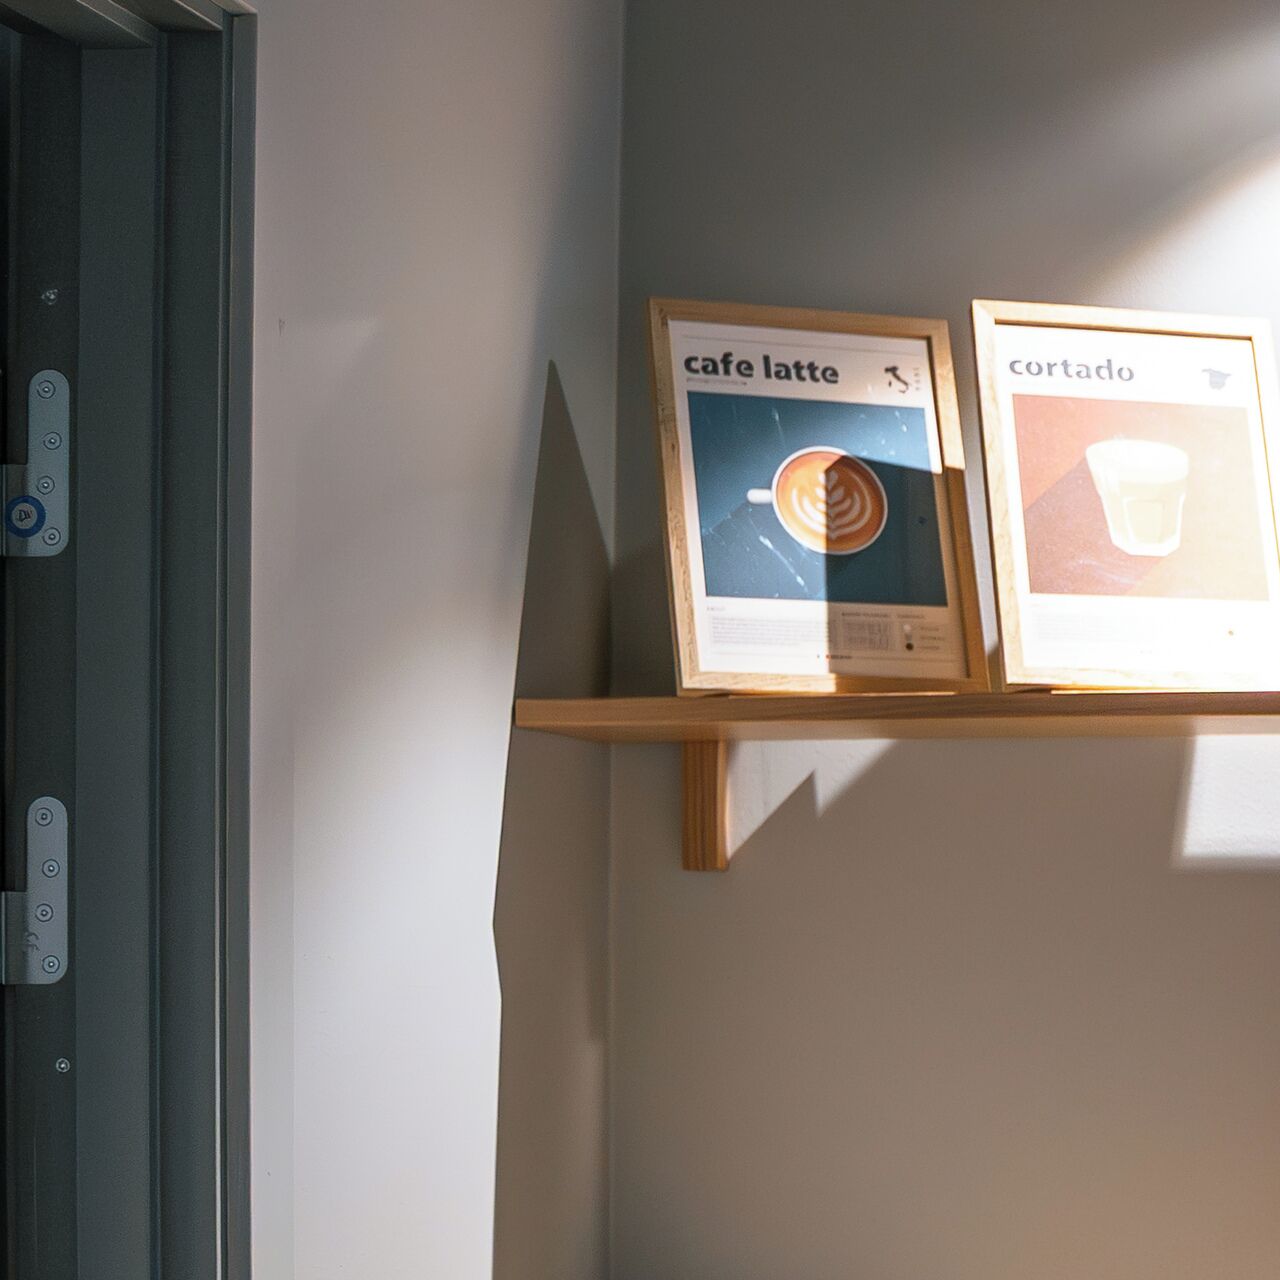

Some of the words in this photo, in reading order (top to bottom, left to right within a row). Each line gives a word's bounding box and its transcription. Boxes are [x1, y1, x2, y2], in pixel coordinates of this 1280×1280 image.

[684, 352, 754, 378] cafe
[763, 355, 839, 384] latte
[1009, 358, 1134, 382] cortado
